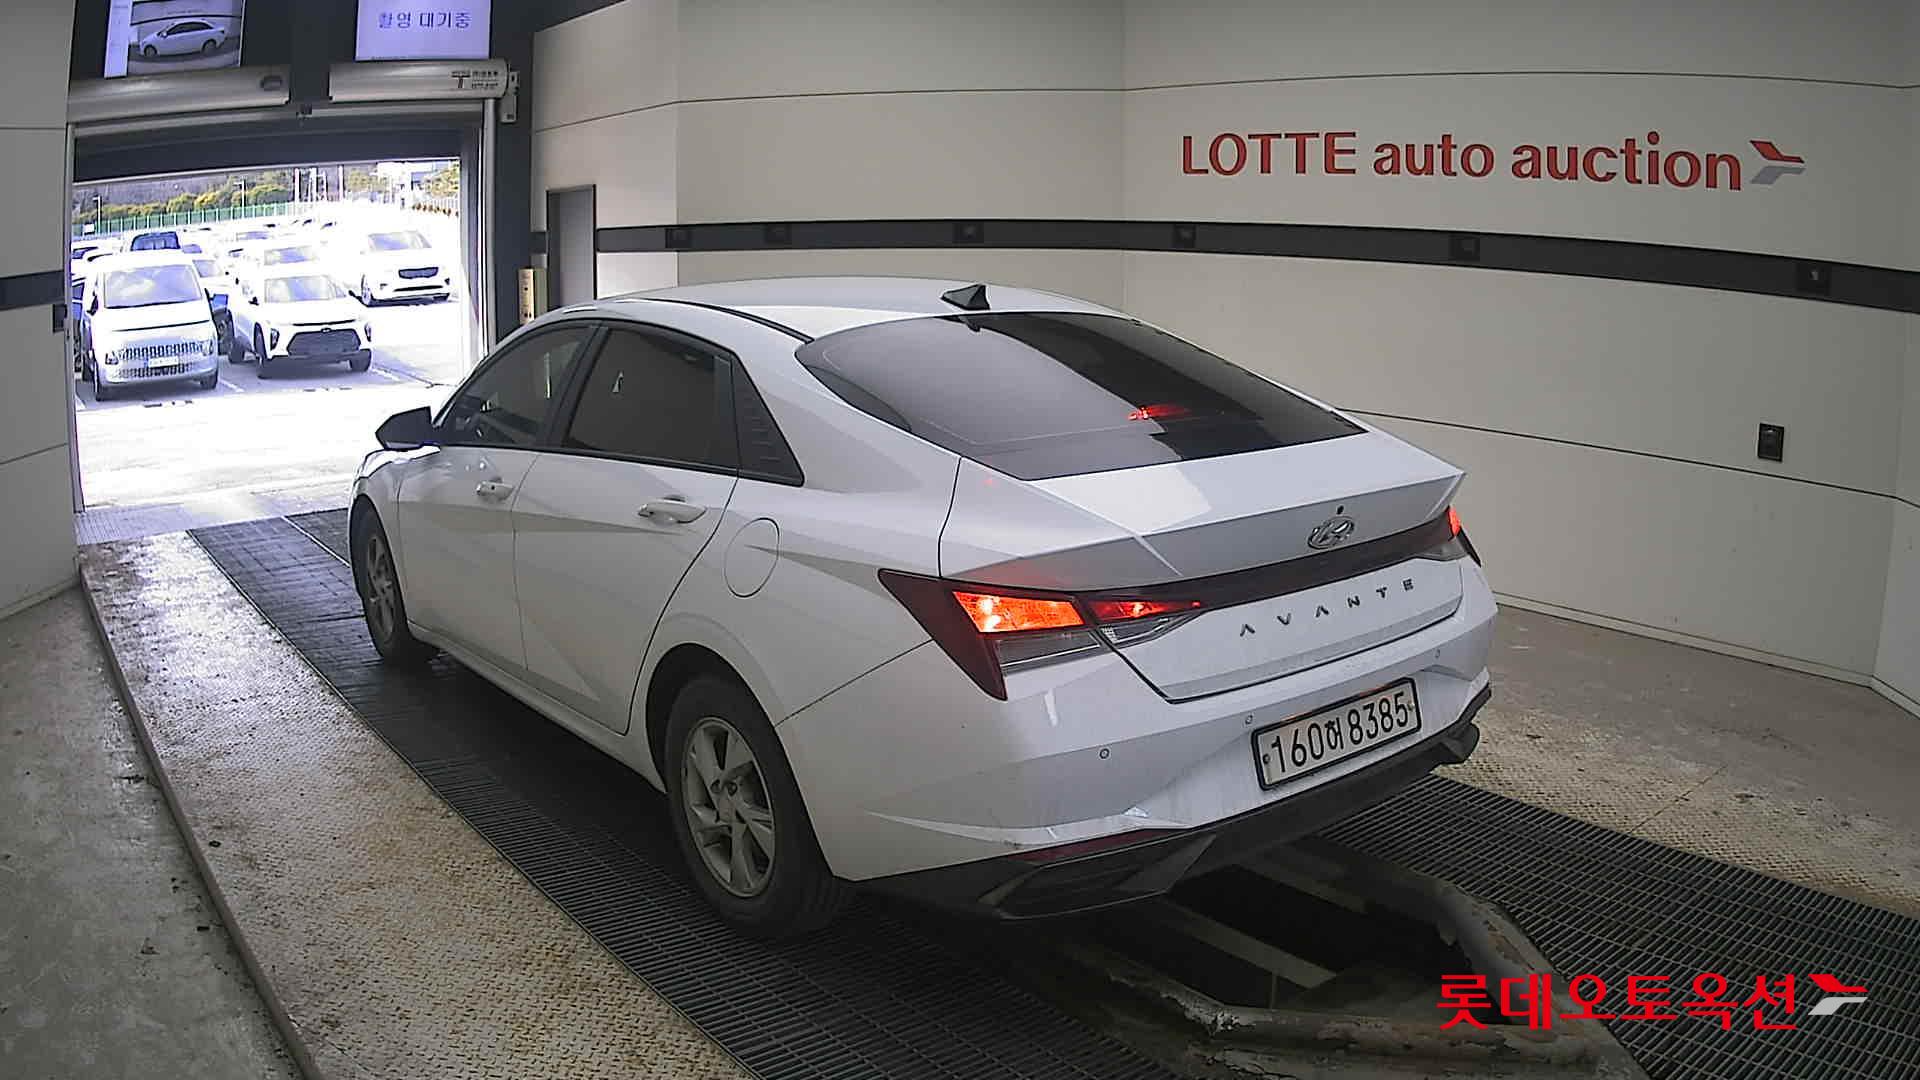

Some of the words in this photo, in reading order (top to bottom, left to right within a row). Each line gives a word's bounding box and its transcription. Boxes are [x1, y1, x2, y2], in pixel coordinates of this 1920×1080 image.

[419, 11, 471, 29] 대기중
[1182, 131, 1357, 175] LOTTE
[1374, 133, 1495, 177] auto
[1511, 131, 1742, 191] auction
[1240, 578, 1414, 637] AVANTE
